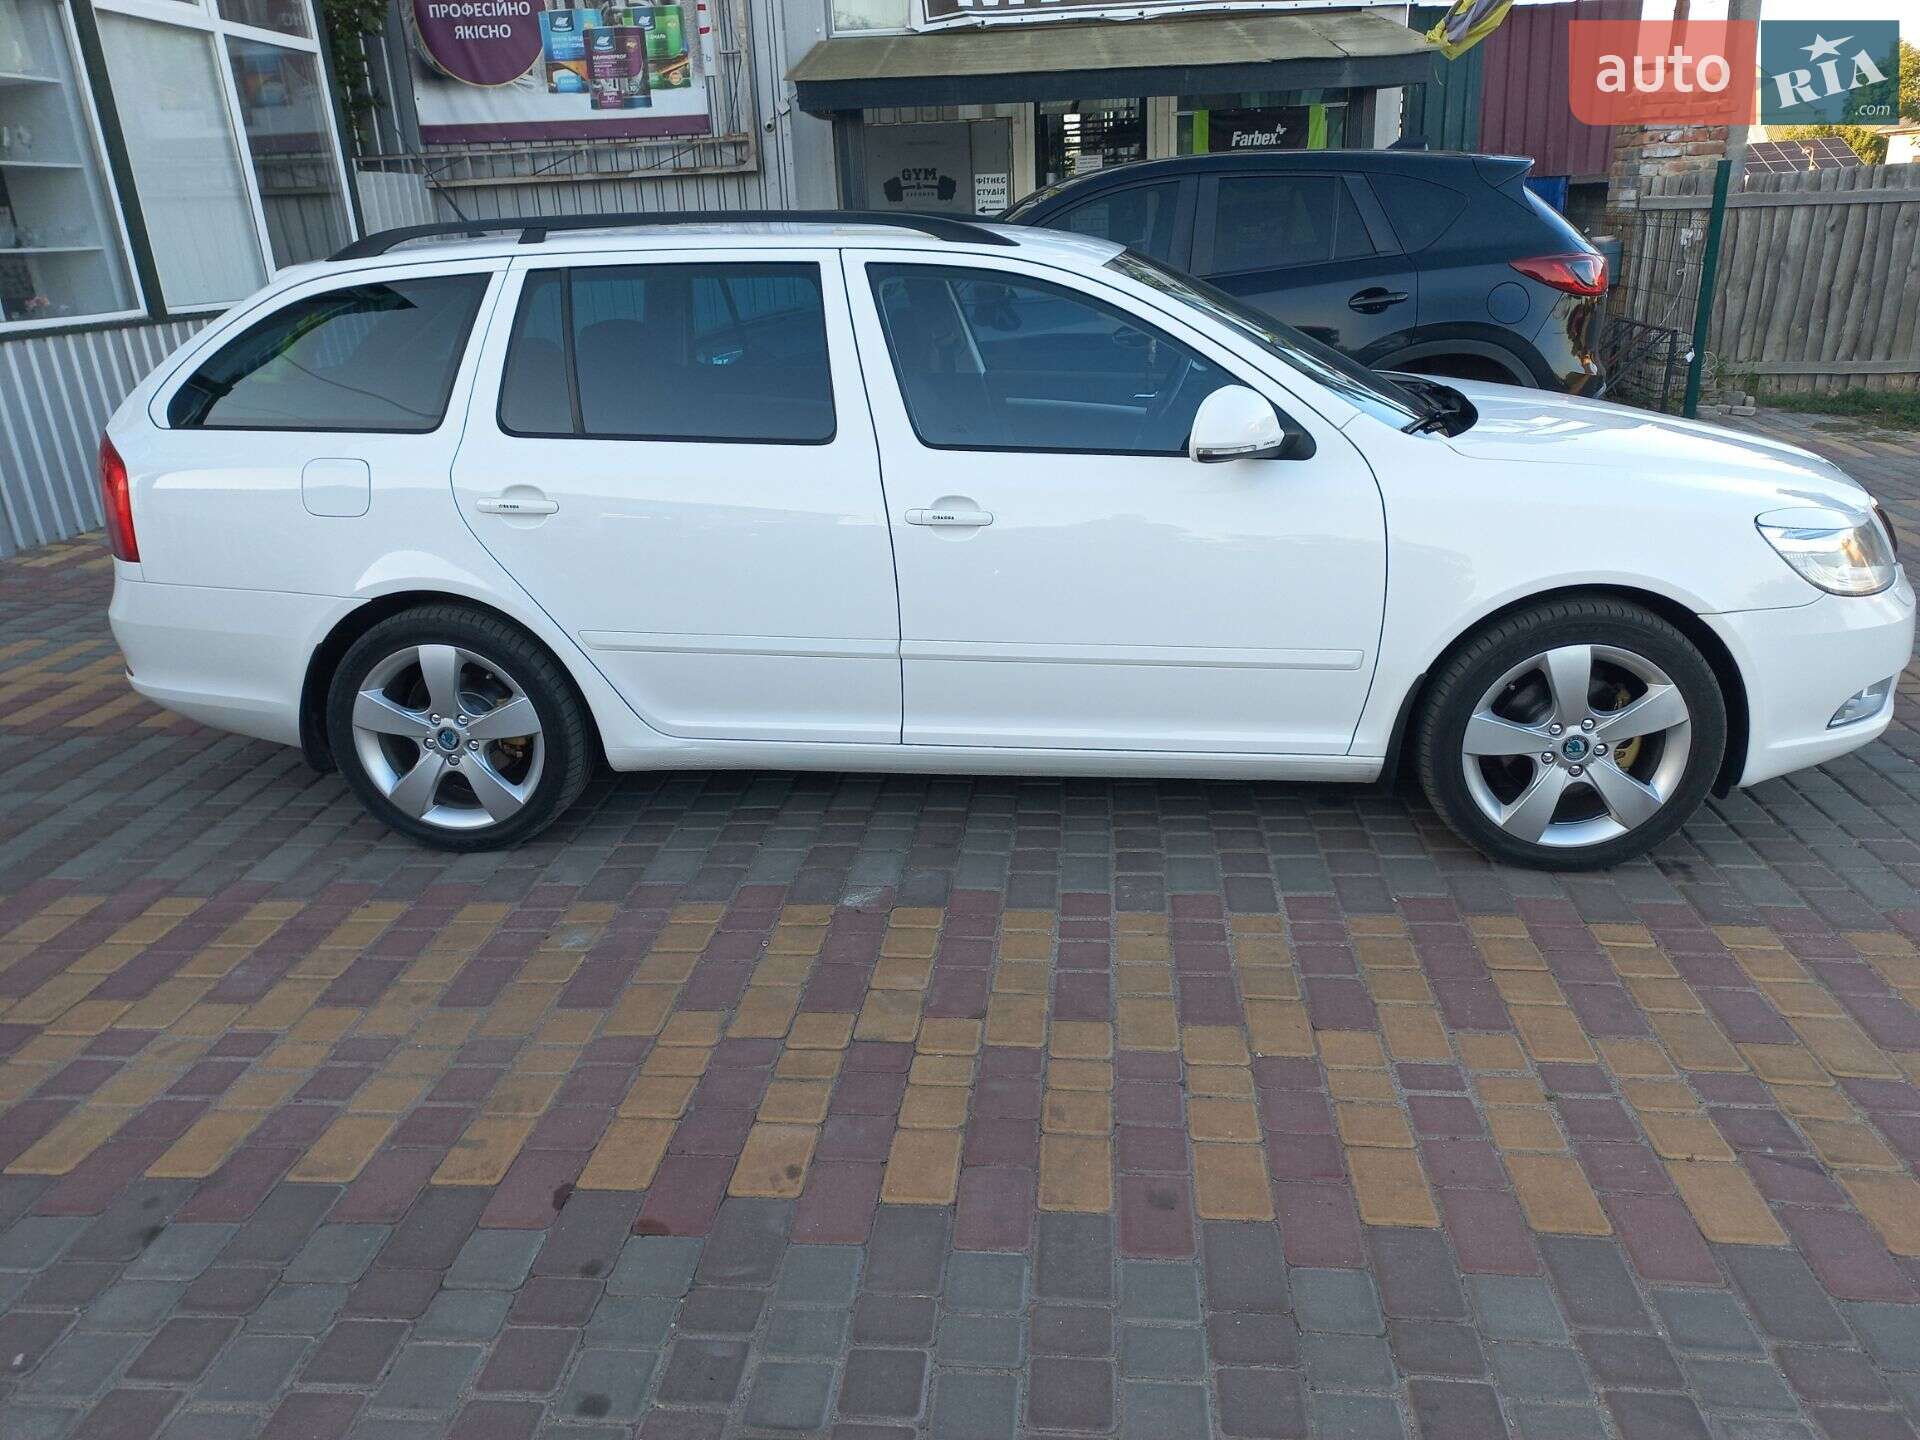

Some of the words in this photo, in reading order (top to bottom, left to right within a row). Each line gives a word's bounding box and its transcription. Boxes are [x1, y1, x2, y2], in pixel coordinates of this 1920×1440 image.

[429, 0, 531, 18] ПРОФЕСІЙНО
[455, 24, 512, 40] ЯКІСНО
[902, 168, 938, 181] GYM
[977, 188, 1006, 196] СТУДІЯ
